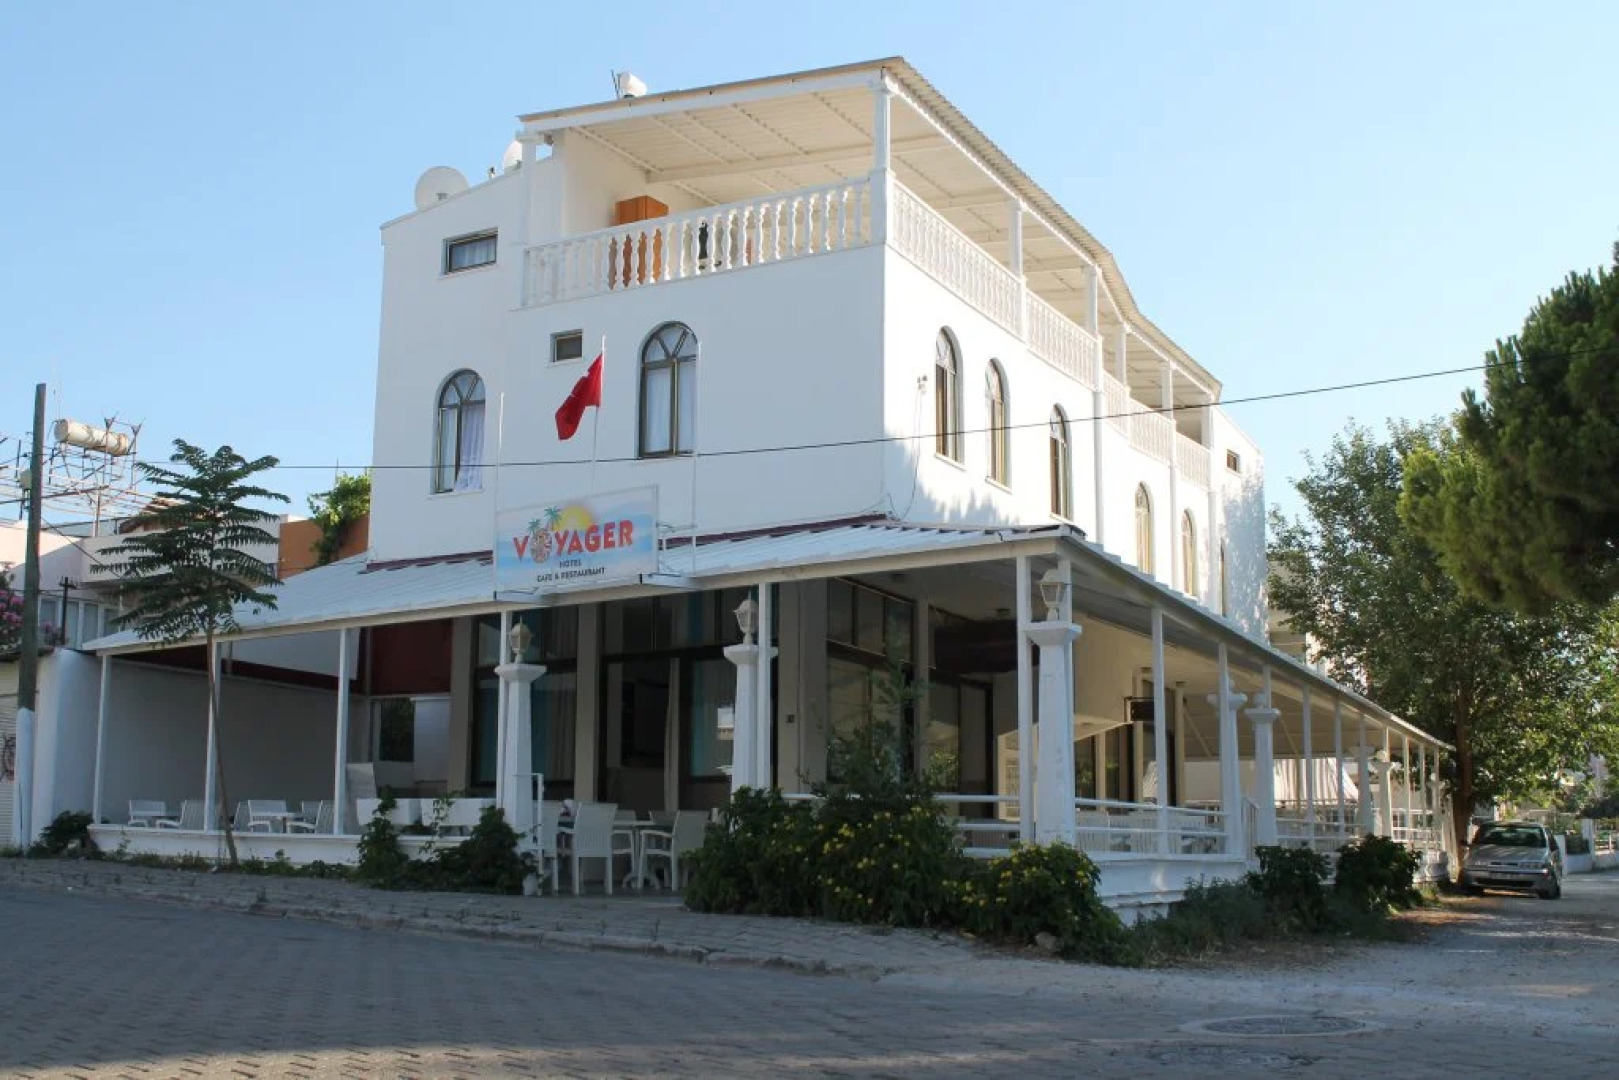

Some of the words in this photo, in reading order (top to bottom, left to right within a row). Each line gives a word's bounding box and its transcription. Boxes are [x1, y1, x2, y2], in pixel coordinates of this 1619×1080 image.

[513, 520, 634, 563] VOYAGER
[559, 559, 582, 568] HOTEL
[537, 573, 552, 582] CAFE
[561, 567, 605, 578] RESTAURANT
